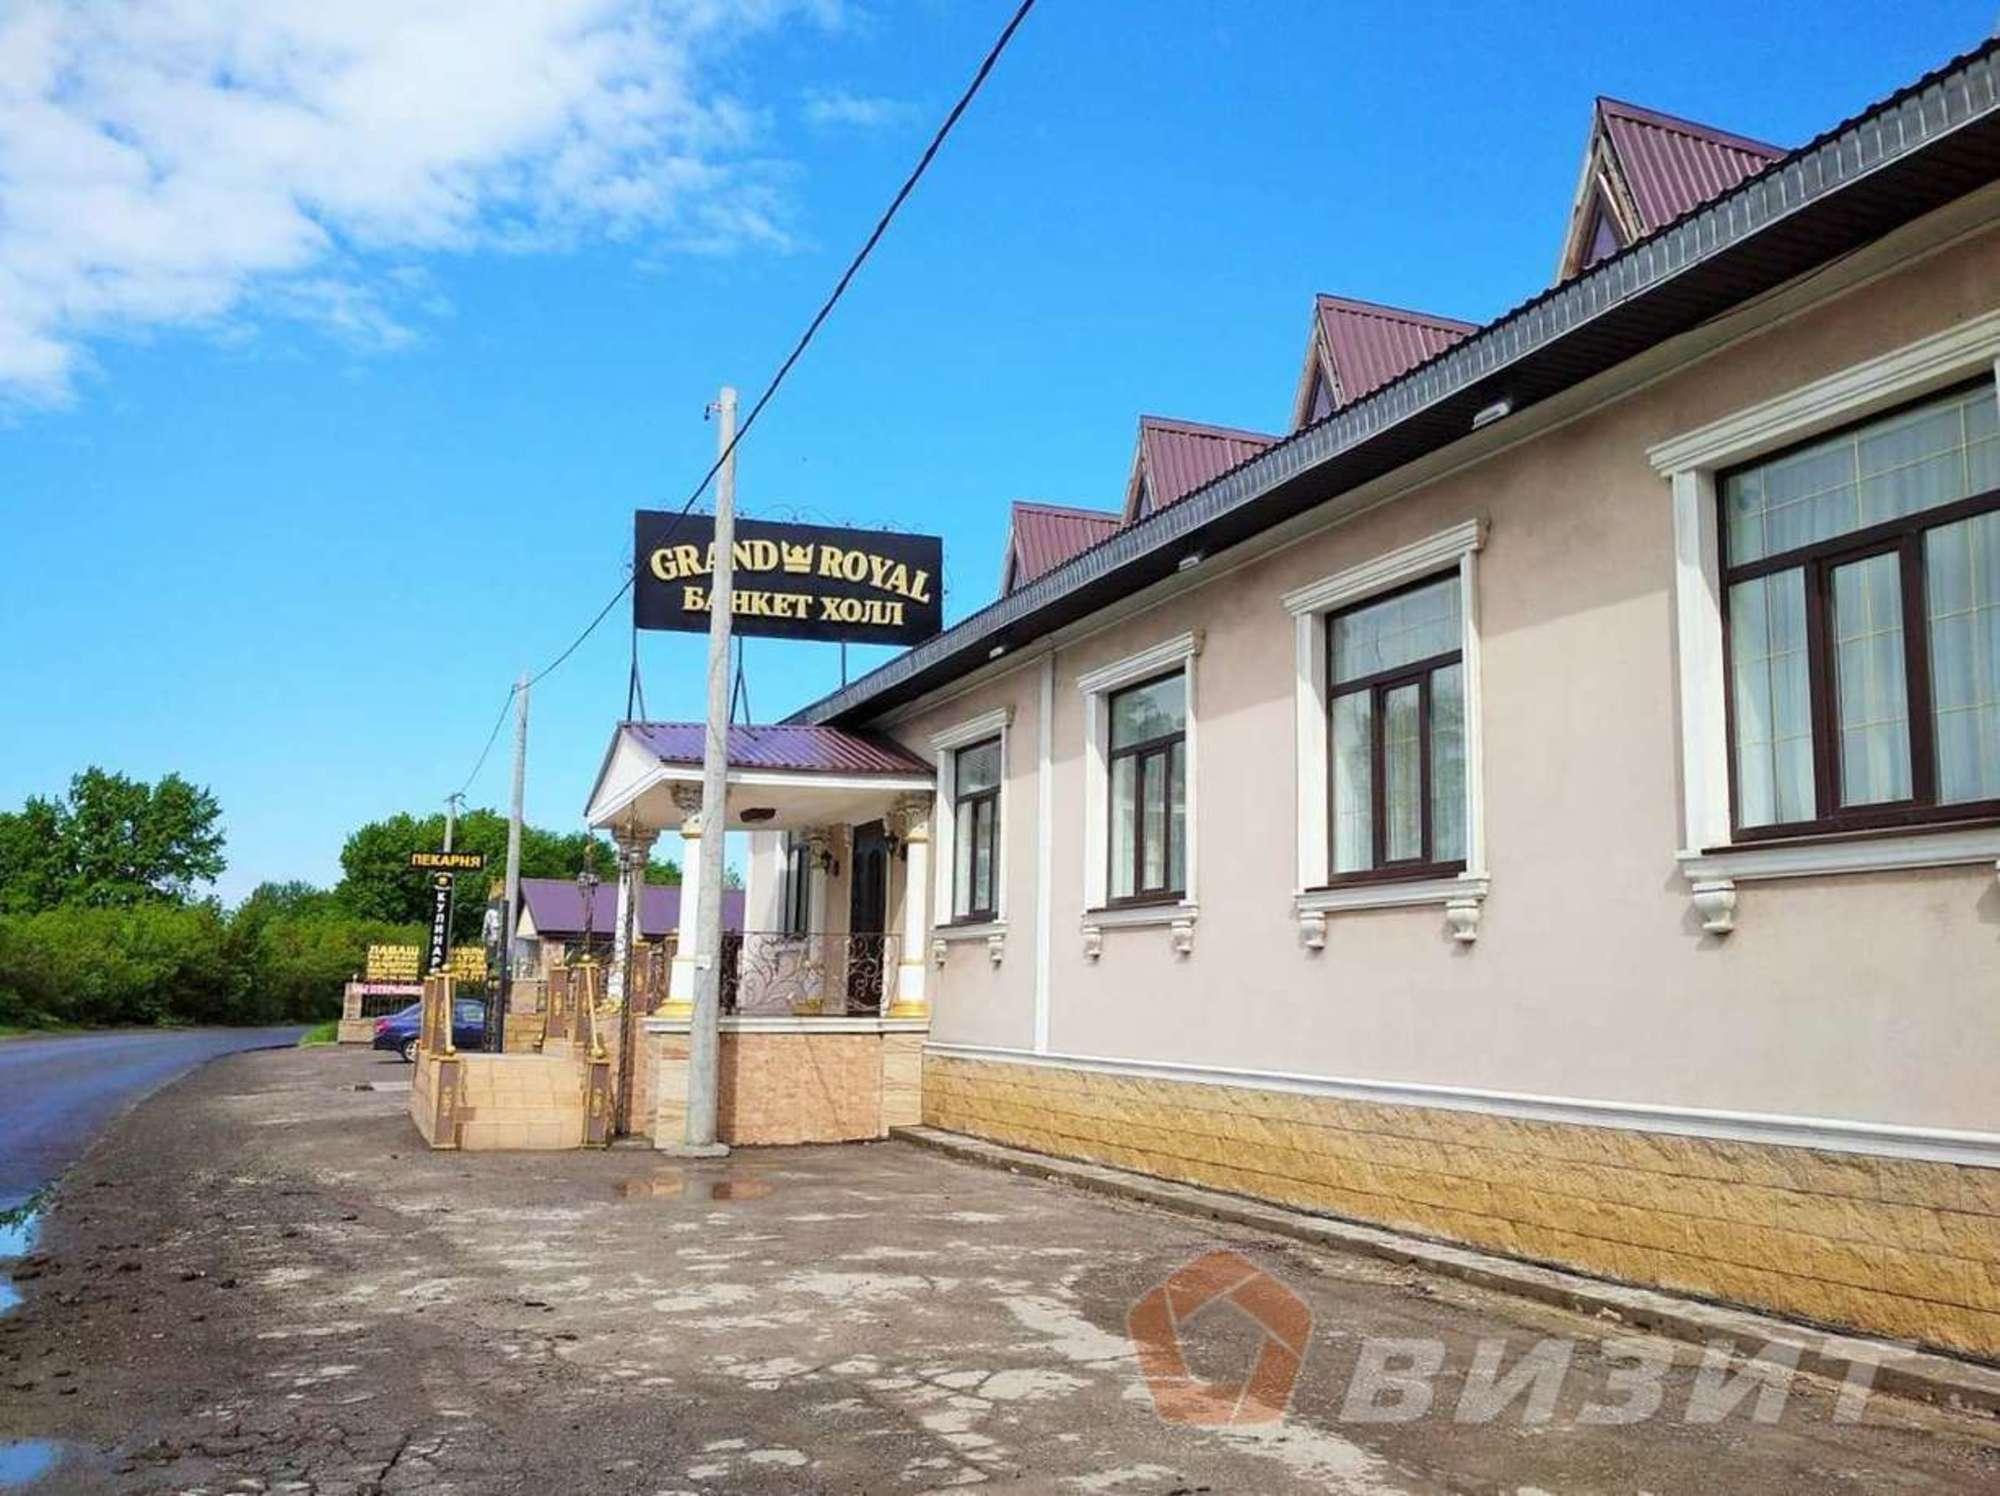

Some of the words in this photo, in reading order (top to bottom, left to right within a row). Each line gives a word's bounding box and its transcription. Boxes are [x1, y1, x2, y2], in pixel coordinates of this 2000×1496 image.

[818, 545, 931, 603] ROYAL
[820, 597, 905, 626] ХОЛЛ
[411, 853, 481, 868] ПЕКАРНЯ
